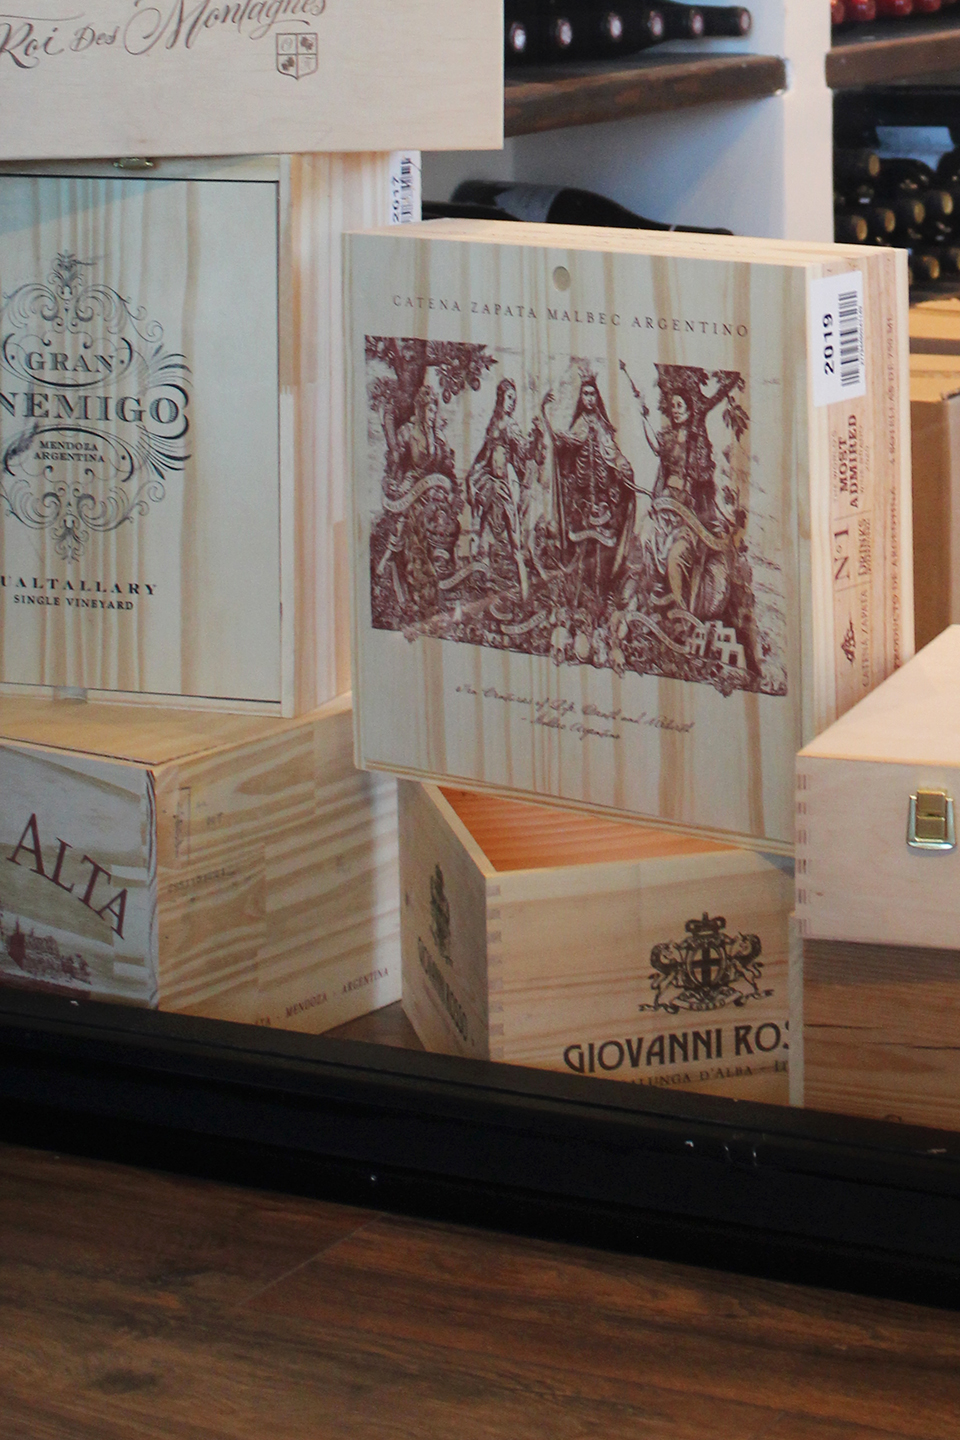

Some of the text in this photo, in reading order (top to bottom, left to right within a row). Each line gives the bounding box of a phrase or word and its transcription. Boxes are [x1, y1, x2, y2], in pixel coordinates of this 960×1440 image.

[69, 24, 120, 52] Des
[393, 294, 749, 338] CATENA ZAPATA MALBEC ARGENTINO
[25, 351, 115, 373] GRAN
[822, 313, 835, 376] 2019
[33, 452, 105, 463] ARGENTINA
[38, 440, 99, 451] MENDOZA
[848, 414, 859, 509] ADMIRED
[838, 436, 848, 492] MOST
[14, 594, 134, 611] SINGLE VINEYARD
[6, 812, 128, 941] ALTA
[343, 967, 389, 994] ARGENTINA
[562, 1020, 790, 1074] GIOVANNI RO
